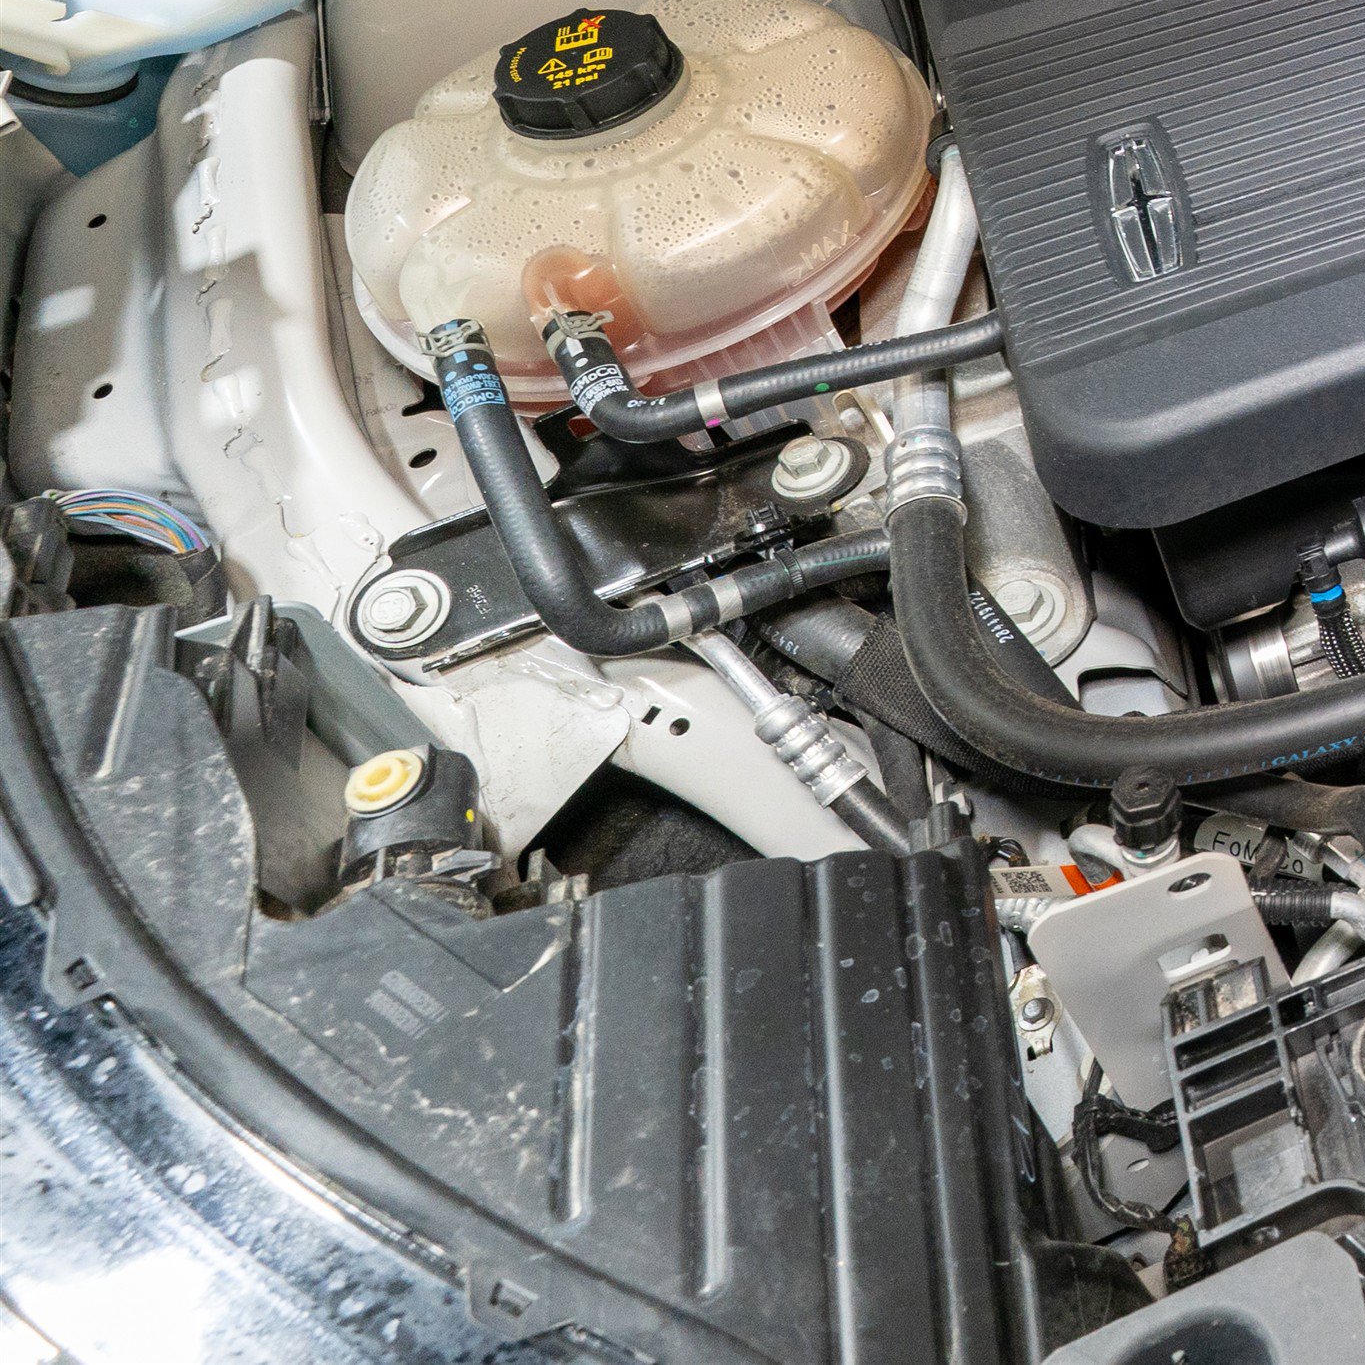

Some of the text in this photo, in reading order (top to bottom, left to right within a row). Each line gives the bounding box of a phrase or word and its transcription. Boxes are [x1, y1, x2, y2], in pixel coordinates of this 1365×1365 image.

[546, 63, 606, 81] 145 kPa
[553, 72, 599, 90] 21 psi
[799, 219, 856, 269] MAX
[1271, 736, 1358, 767] GALAXY
